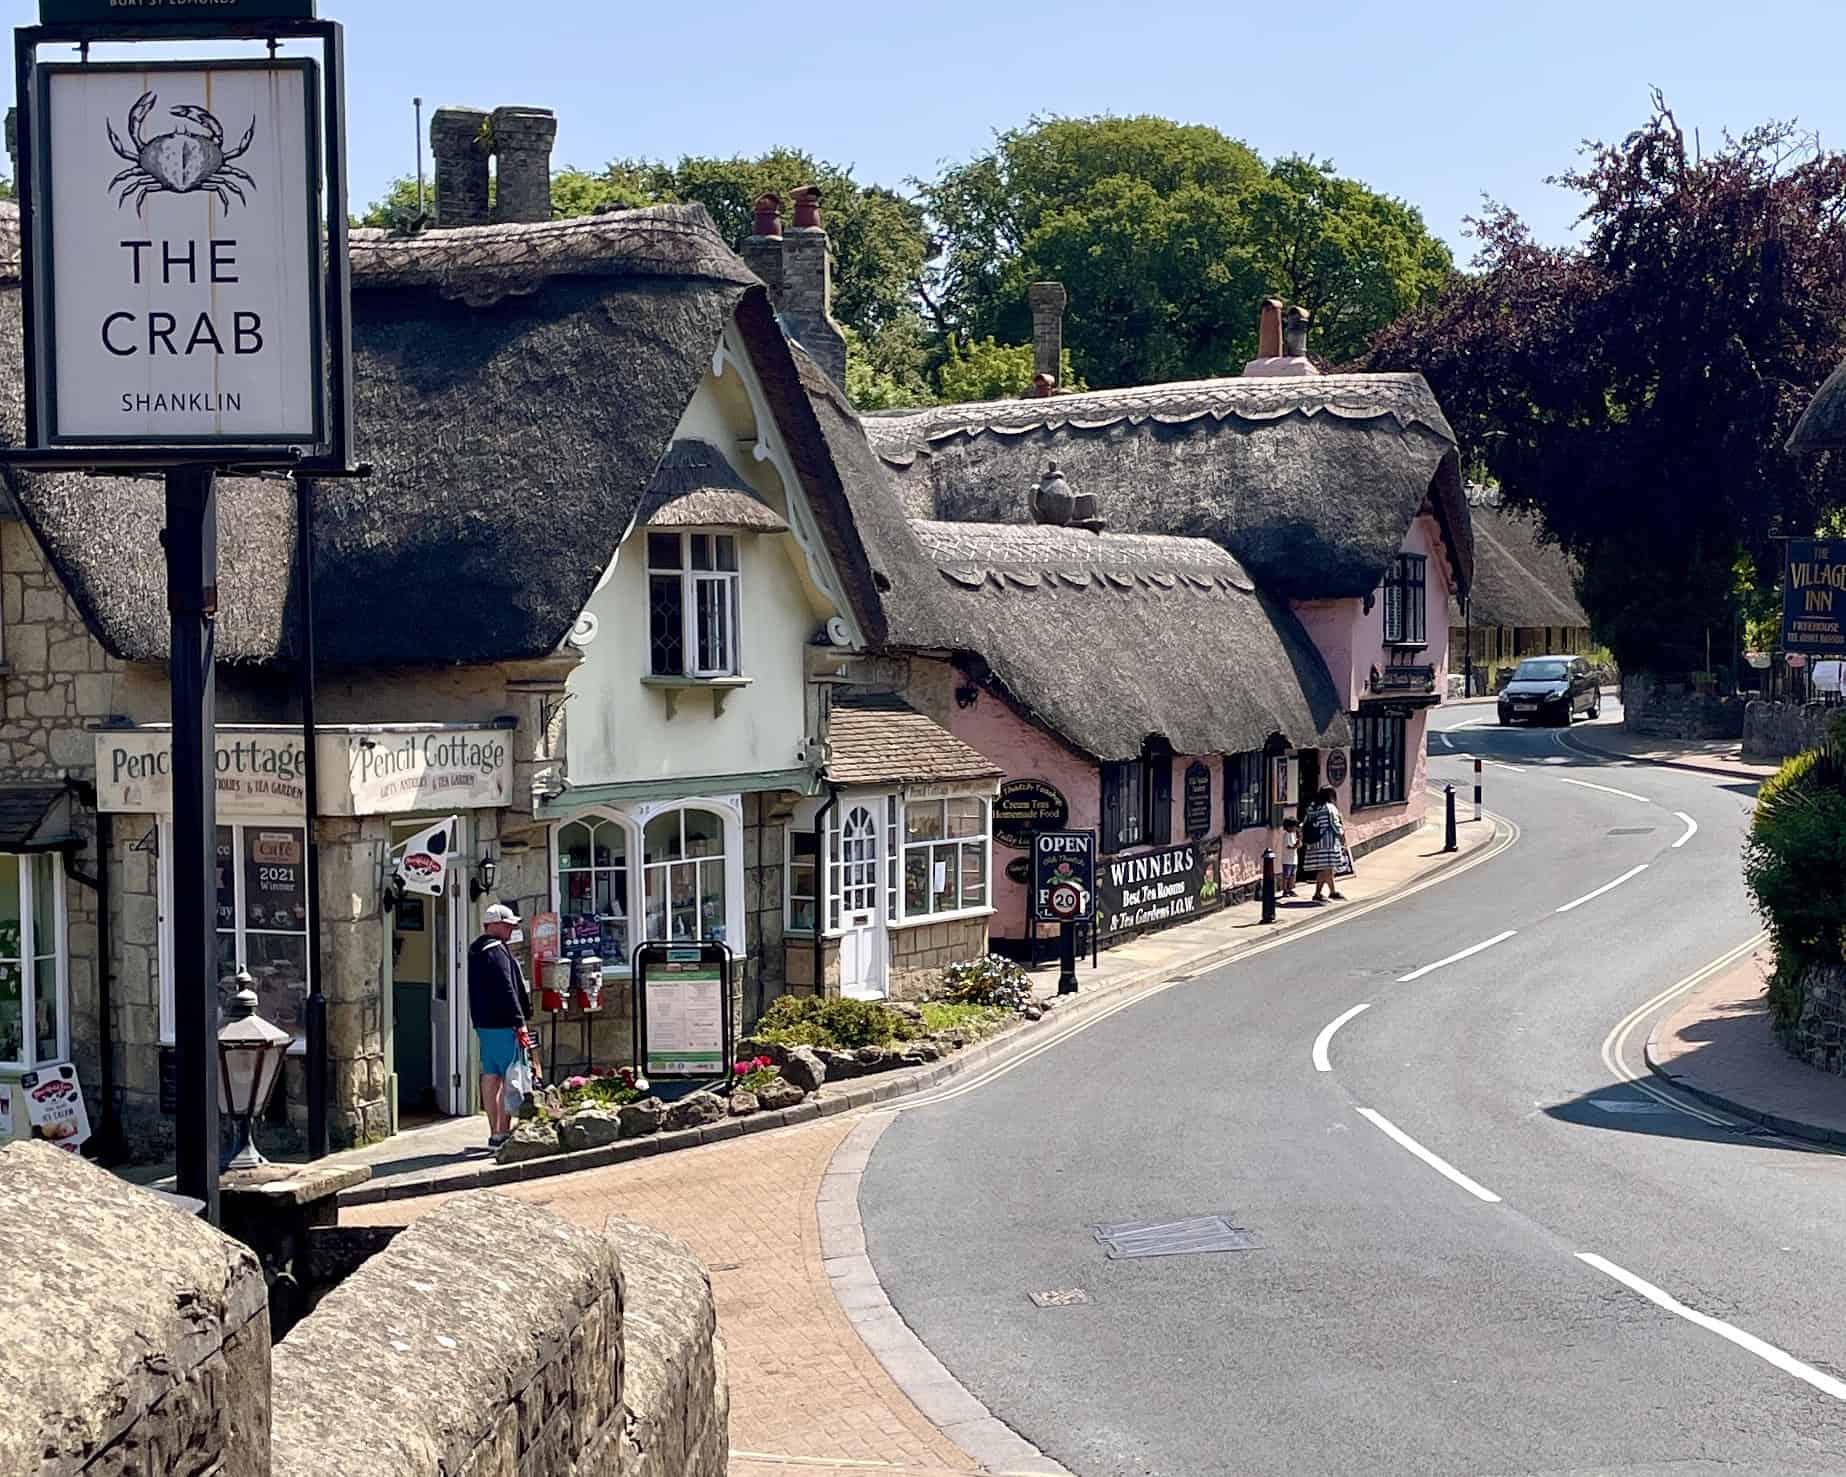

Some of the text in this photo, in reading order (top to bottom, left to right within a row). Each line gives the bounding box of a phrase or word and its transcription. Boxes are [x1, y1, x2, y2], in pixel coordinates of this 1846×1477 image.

[120, 240, 239, 284] THE
[101, 311, 264, 356] CRAB
[122, 393, 241, 412] SHANKLIN
[1806, 591, 1832, 611] INN
[112, 741, 305, 783] Penc ottage
[362, 734, 504, 783] Pencil Cottage
[1040, 809, 1060, 818] Food
[1040, 836, 1088, 853] OPEN
[259, 867, 296, 882] 2021
[1110, 848, 1194, 887] WINNERS
[1055, 894, 1075, 906] 20
[1123, 881, 1185, 908] Best Tea Rooms
[1110, 914, 1119, 931] &
[1120, 912, 1134, 929] Tea
[1135, 904, 1170, 925] Gardens
